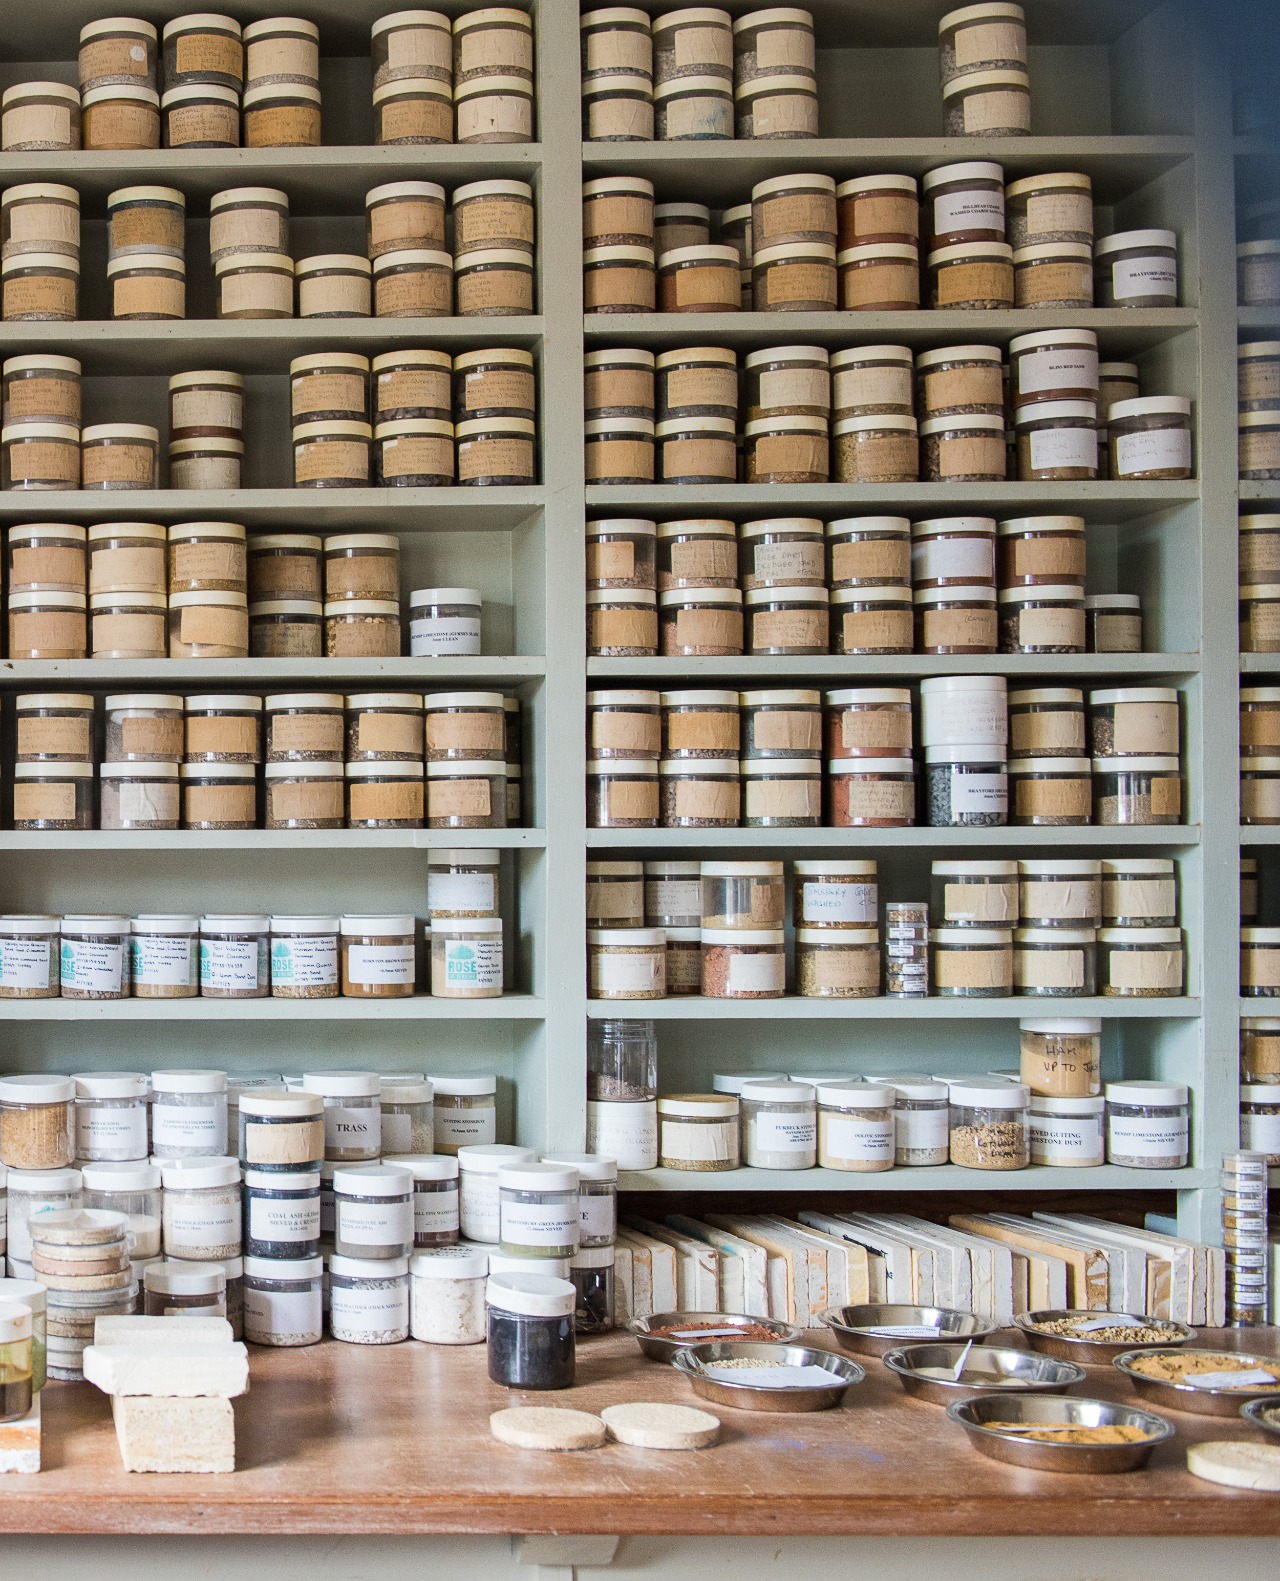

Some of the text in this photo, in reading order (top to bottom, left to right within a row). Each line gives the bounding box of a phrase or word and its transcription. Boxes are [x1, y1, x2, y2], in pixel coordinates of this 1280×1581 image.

[273, 959, 294, 971] ROSE
[448, 961, 477, 973] ROSE
[1046, 1045, 1077, 1056] HAM
[1044, 1062, 1058, 1072] UP
[1062, 1063, 1076, 1072] TO
[336, 1123, 368, 1132] TRASS
